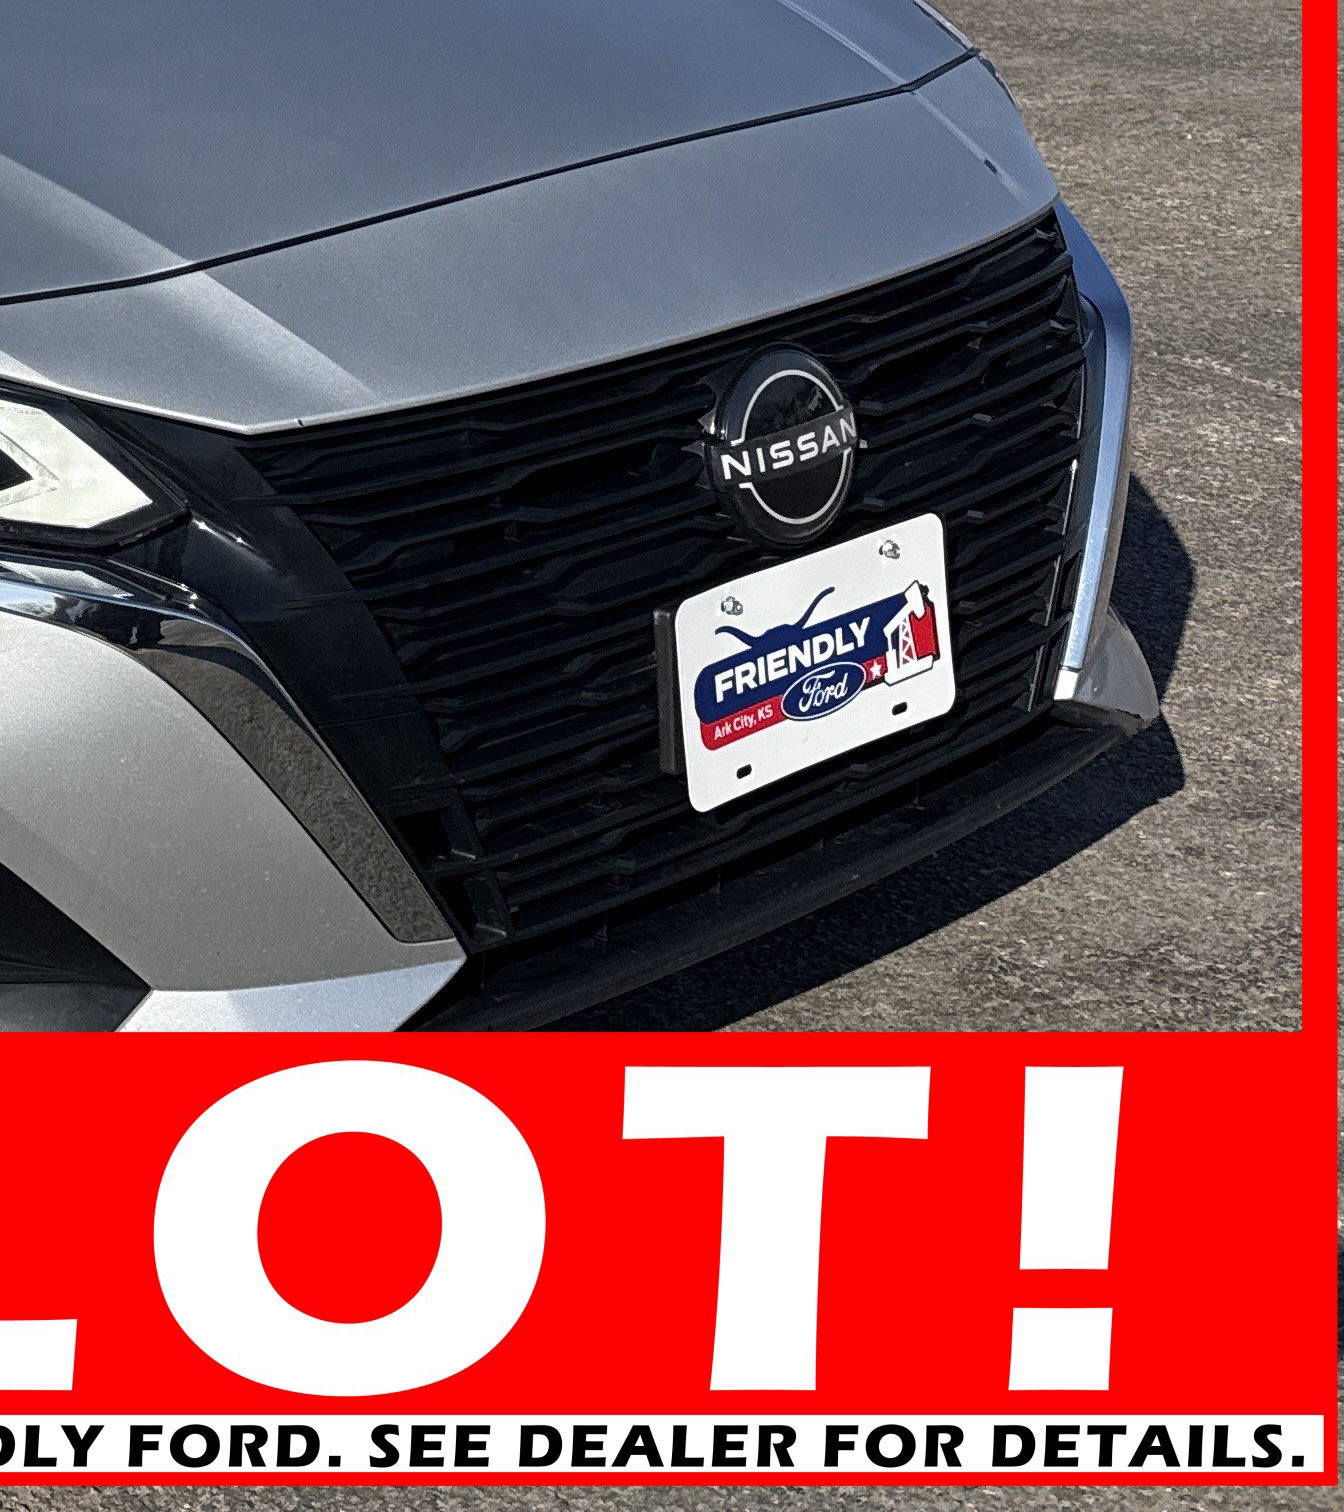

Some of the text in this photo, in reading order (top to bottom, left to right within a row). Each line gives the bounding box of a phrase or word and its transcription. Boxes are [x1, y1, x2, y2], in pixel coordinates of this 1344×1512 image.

[720, 412, 857, 480] NISSAN
[714, 616, 870, 704] FRIENDLY
[798, 669, 849, 713] Ford
[714, 704, 774, 740] Ark City, KS
